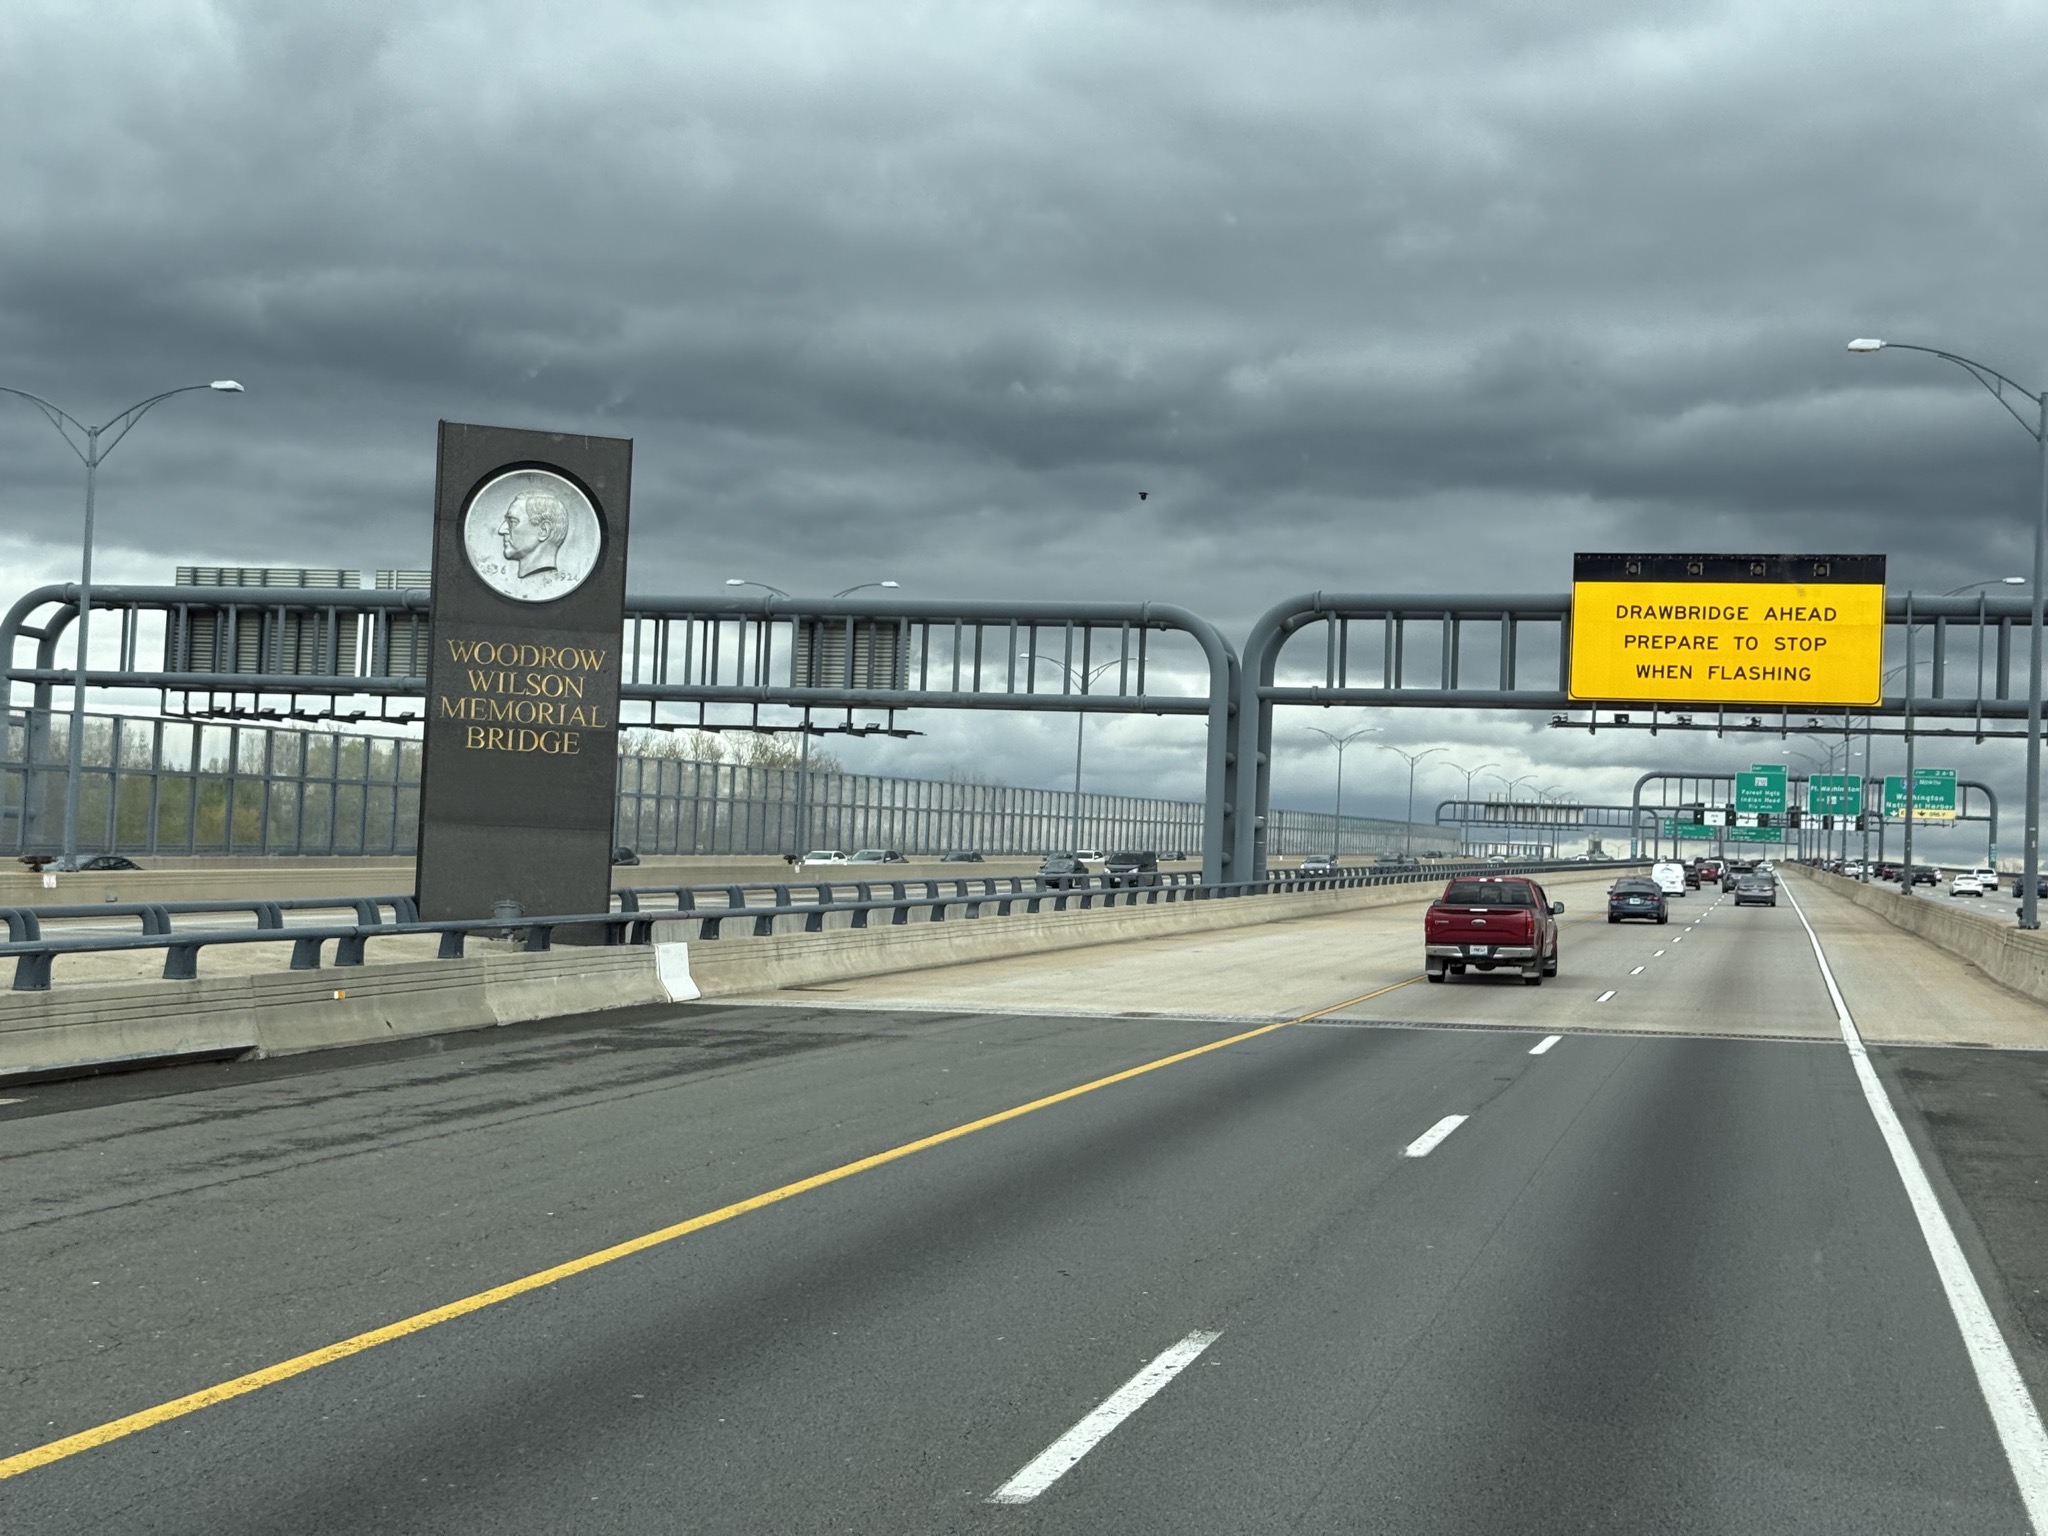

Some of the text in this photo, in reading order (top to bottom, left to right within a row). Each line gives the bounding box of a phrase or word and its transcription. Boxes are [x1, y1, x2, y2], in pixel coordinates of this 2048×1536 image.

[1616, 604, 1837, 622] DRAWBRIDGE AHEAD
[1624, 634, 1827, 652] PREPARE TO STOP
[448, 640, 606, 671] WOODROW
[468, 669, 585, 698] WILSON
[1636, 664, 1811, 682] WHEN FLASHING
[440, 697, 608, 729] MEMORIAL
[466, 726, 581, 755] BRIDGE
[1896, 794, 1944, 802] Wahington
